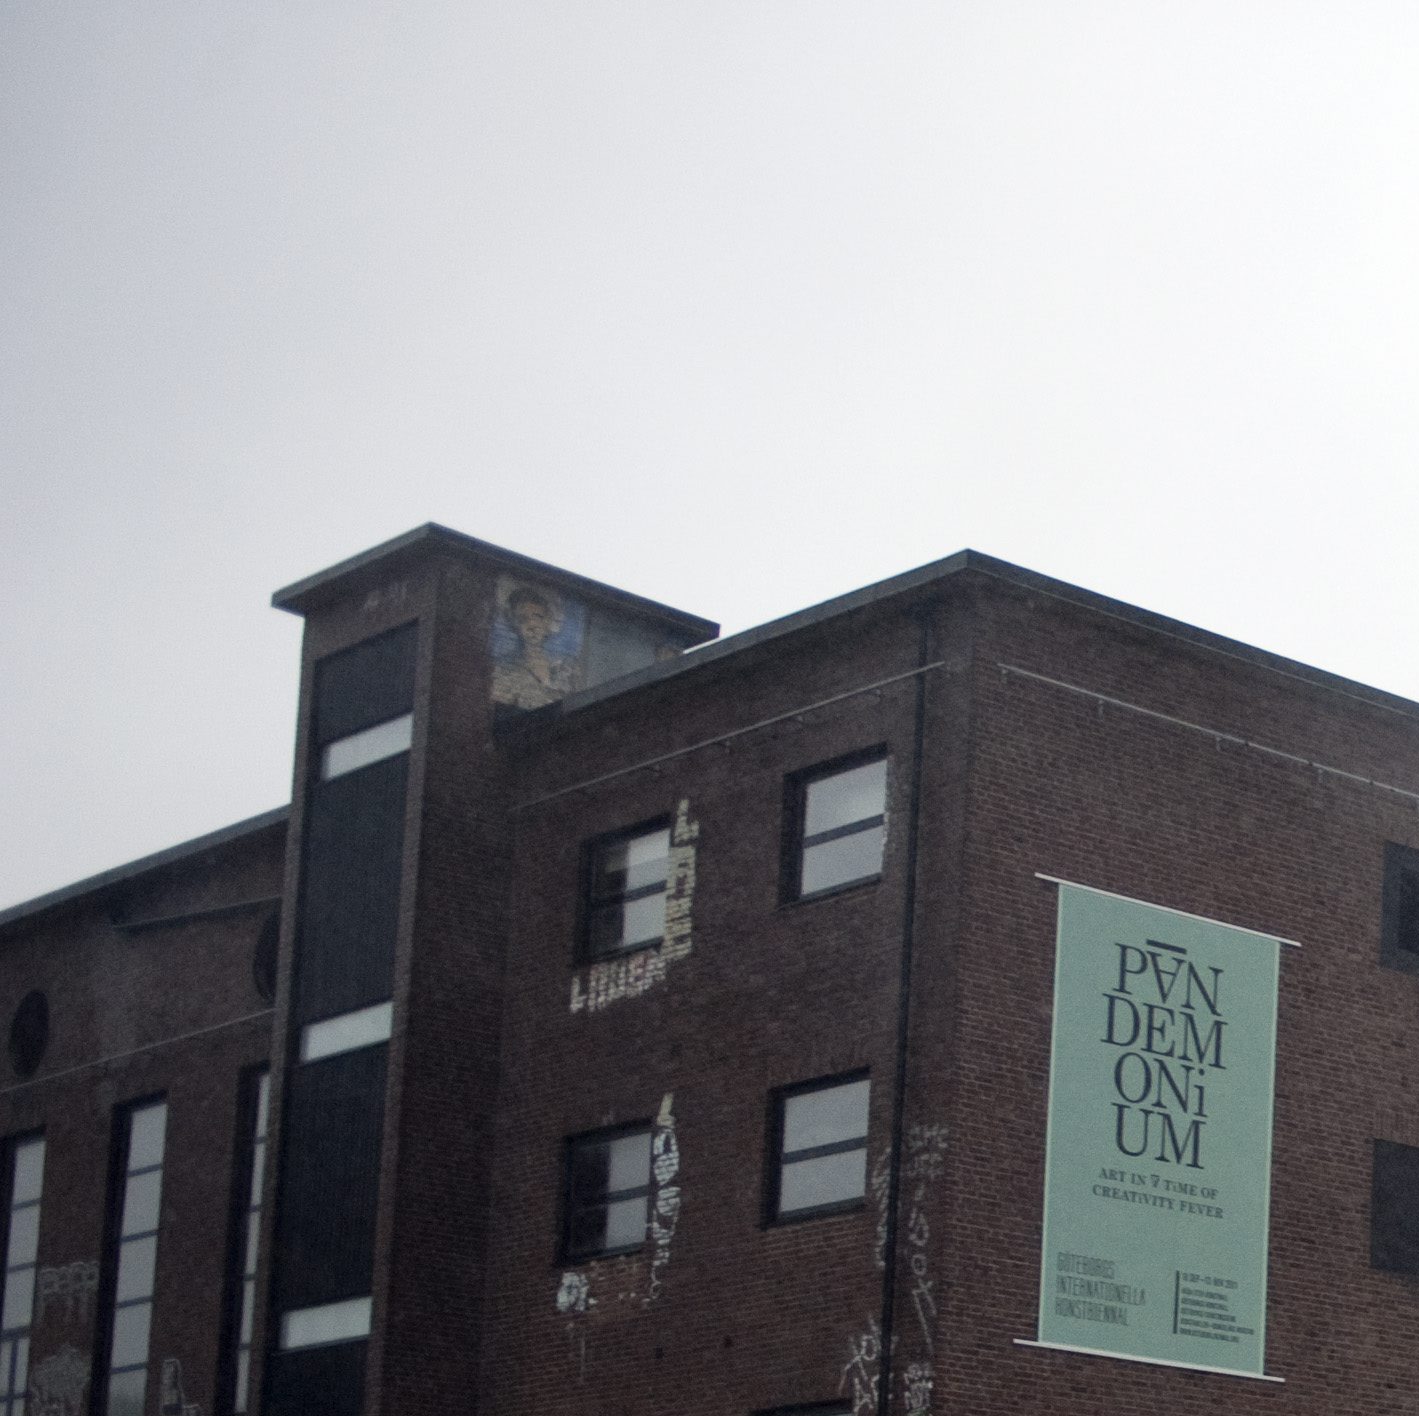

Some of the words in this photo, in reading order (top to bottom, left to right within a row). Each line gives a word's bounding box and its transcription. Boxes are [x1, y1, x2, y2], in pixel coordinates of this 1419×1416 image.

[1101, 993, 1229, 1070] DEM
[1111, 1102, 1207, 1169] UM
[1099, 1167, 1127, 1182] ART
[1130, 1173, 1148, 1185] IN
[1200, 1187, 1219, 1200] OF
[1179, 1200, 1224, 1219] FEVER
